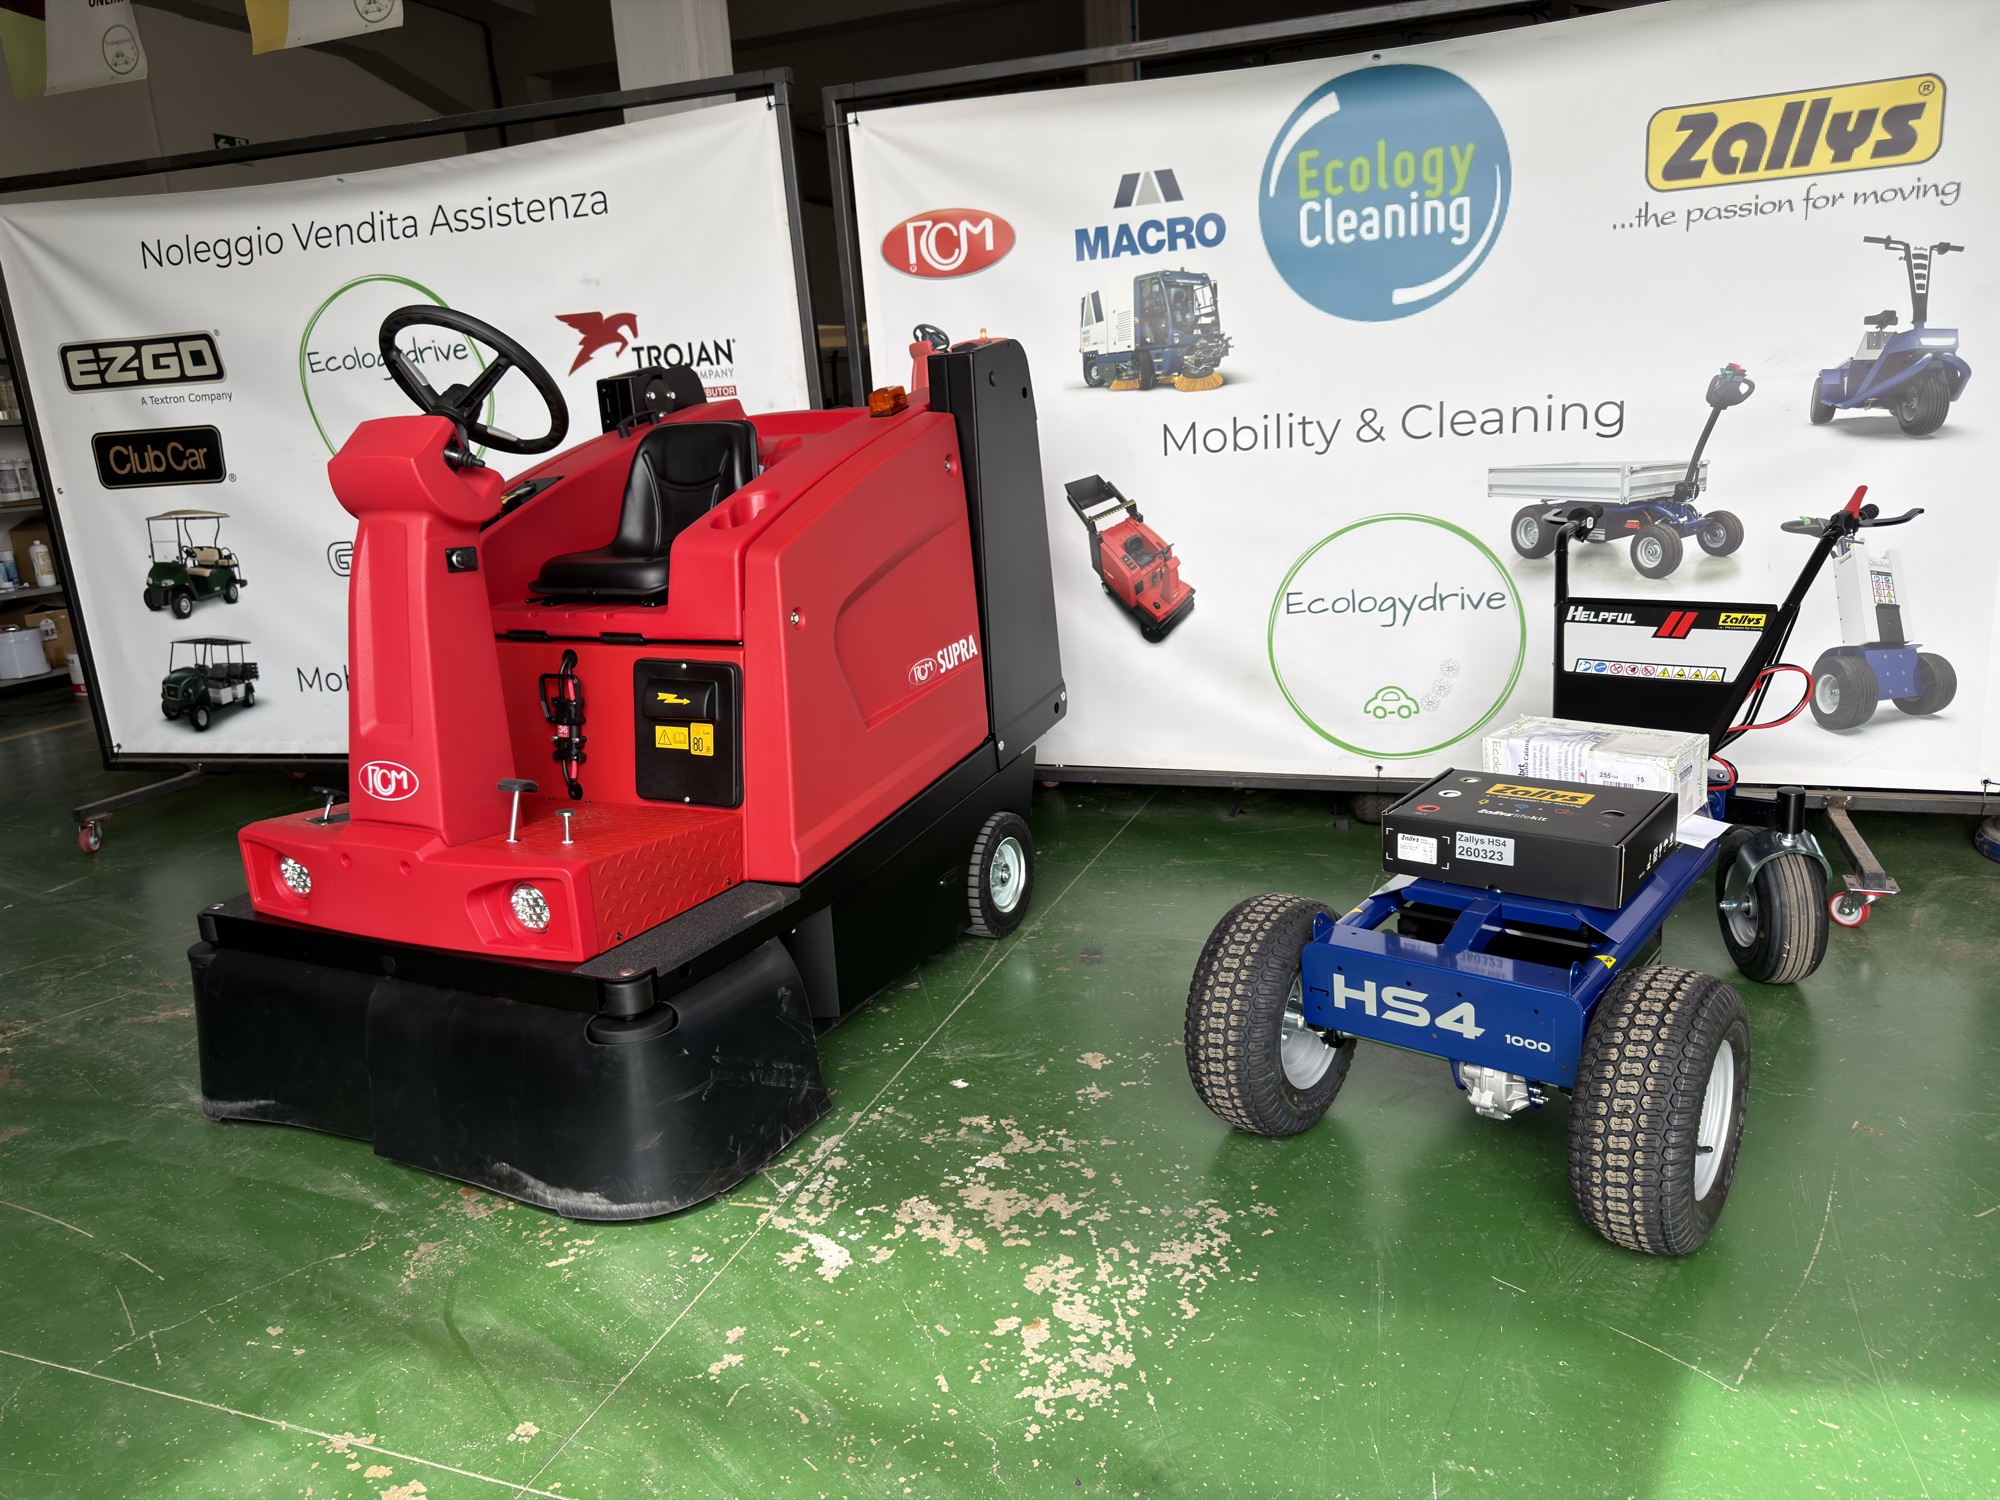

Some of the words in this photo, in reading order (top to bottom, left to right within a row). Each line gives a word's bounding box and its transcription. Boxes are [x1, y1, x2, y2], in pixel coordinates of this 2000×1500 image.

[1661, 97, 1926, 182] Zallys
[1298, 138, 1475, 200] Ecology
[1299, 190, 1471, 248] Cleaning
[1686, 194, 1794, 232] passion
[1802, 182, 1845, 220] for
[1853, 177, 1962, 206] moving
[140, 226, 284, 269] Noleggio
[292, 210, 419, 252] Vendita
[429, 190, 609, 236] Assistenza
[906, 217, 994, 271] RCM
[1075, 212, 1227, 262] MACRO
[66, 339, 218, 386] EZGO
[631, 338, 734, 369] TROJAN
[699, 367, 734, 380] MPANY
[141, 397, 148, 406] A
[149, 394, 185, 405] Textron
[188, 391, 233, 404] Company
[704, 386, 736, 397] BUTOR
[1162, 412, 1342, 456] Mobility
[1355, 407, 1386, 444] &
[1401, 393, 1625, 439] Cleaning
[109, 444, 167, 475] Club
[167, 441, 208, 471] Car
[1286, 582, 1507, 627] Ecologydrive
[1566, 605, 1636, 624] HELPFUL
[1721, 614, 1763, 625] Zallys
[937, 634, 978, 674] SUPRA
[1492, 741, 1502, 774] Ecolo
[367, 765, 408, 797] RCM
[1599, 771, 1611, 779] 255
[1492, 785, 1585, 802] Zallys
[1458, 833, 1485, 846] Zallys
[1487, 837, 1507, 848] HS4
[1458, 845, 1504, 862] 260323
[1332, 973, 1486, 1040] HS4
[1504, 1033, 1551, 1053] 1000
